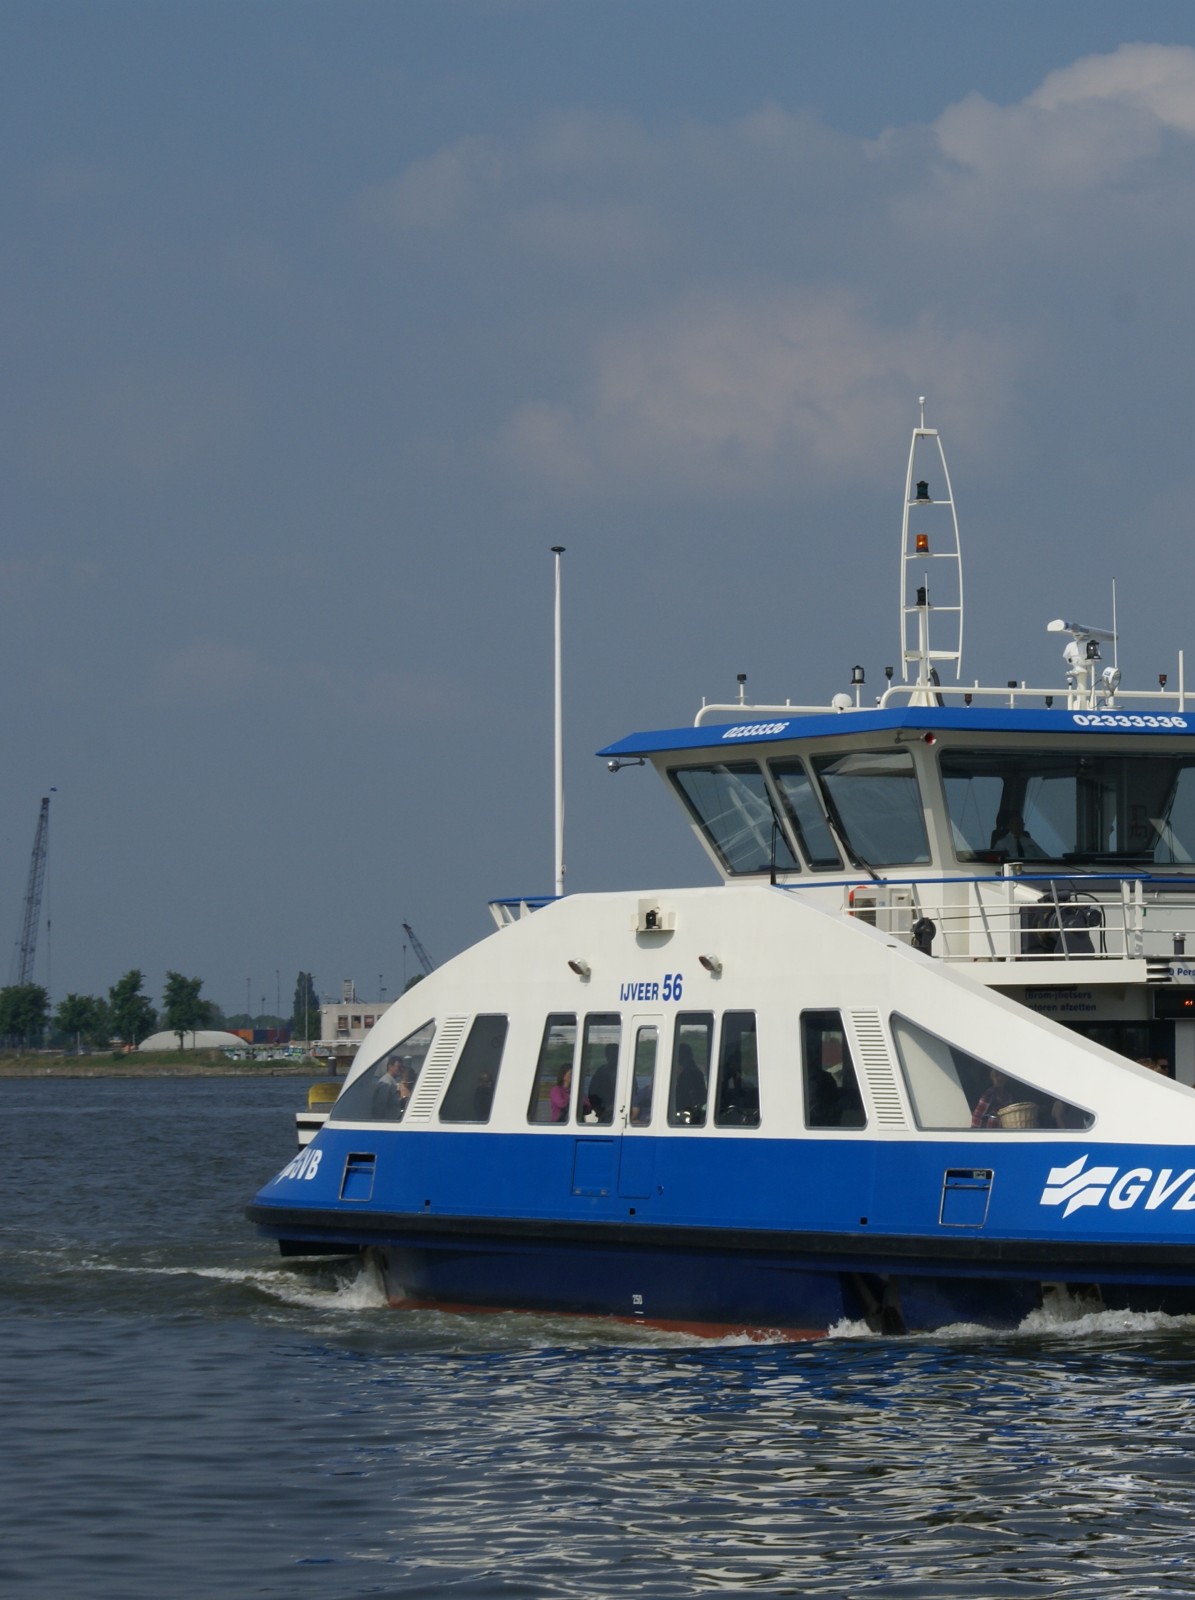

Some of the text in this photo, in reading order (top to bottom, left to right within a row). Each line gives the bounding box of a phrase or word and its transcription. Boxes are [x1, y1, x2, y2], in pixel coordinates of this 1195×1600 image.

[1073, 714, 1188, 728] 02333336
[620, 973, 683, 1001] IJVEER 56
